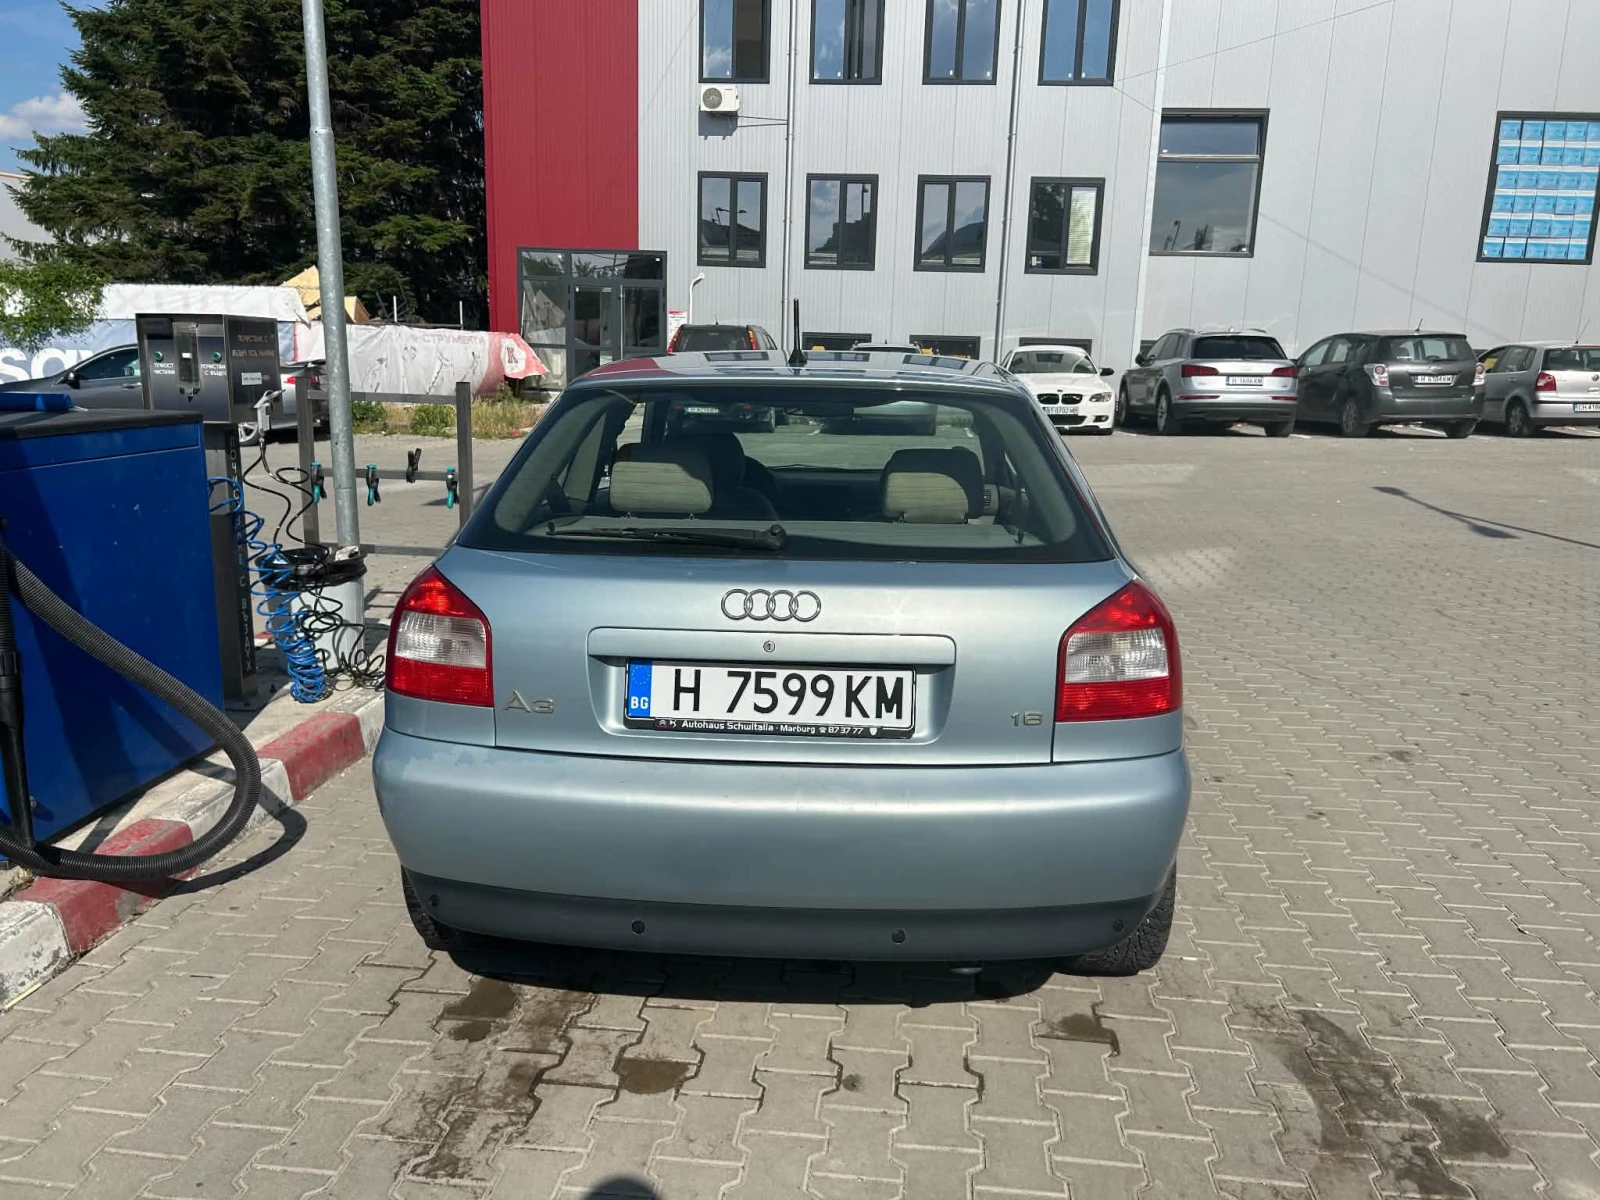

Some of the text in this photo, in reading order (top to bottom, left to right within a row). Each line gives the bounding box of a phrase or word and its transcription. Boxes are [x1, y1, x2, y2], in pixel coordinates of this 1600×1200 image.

[502, 690, 555, 714] A3
[630, 696, 649, 710] BG
[673, 668, 904, 720] H 7599 KM
[681, 719, 725, 730] Autohaus
[780, 724, 816, 734] Marburg
